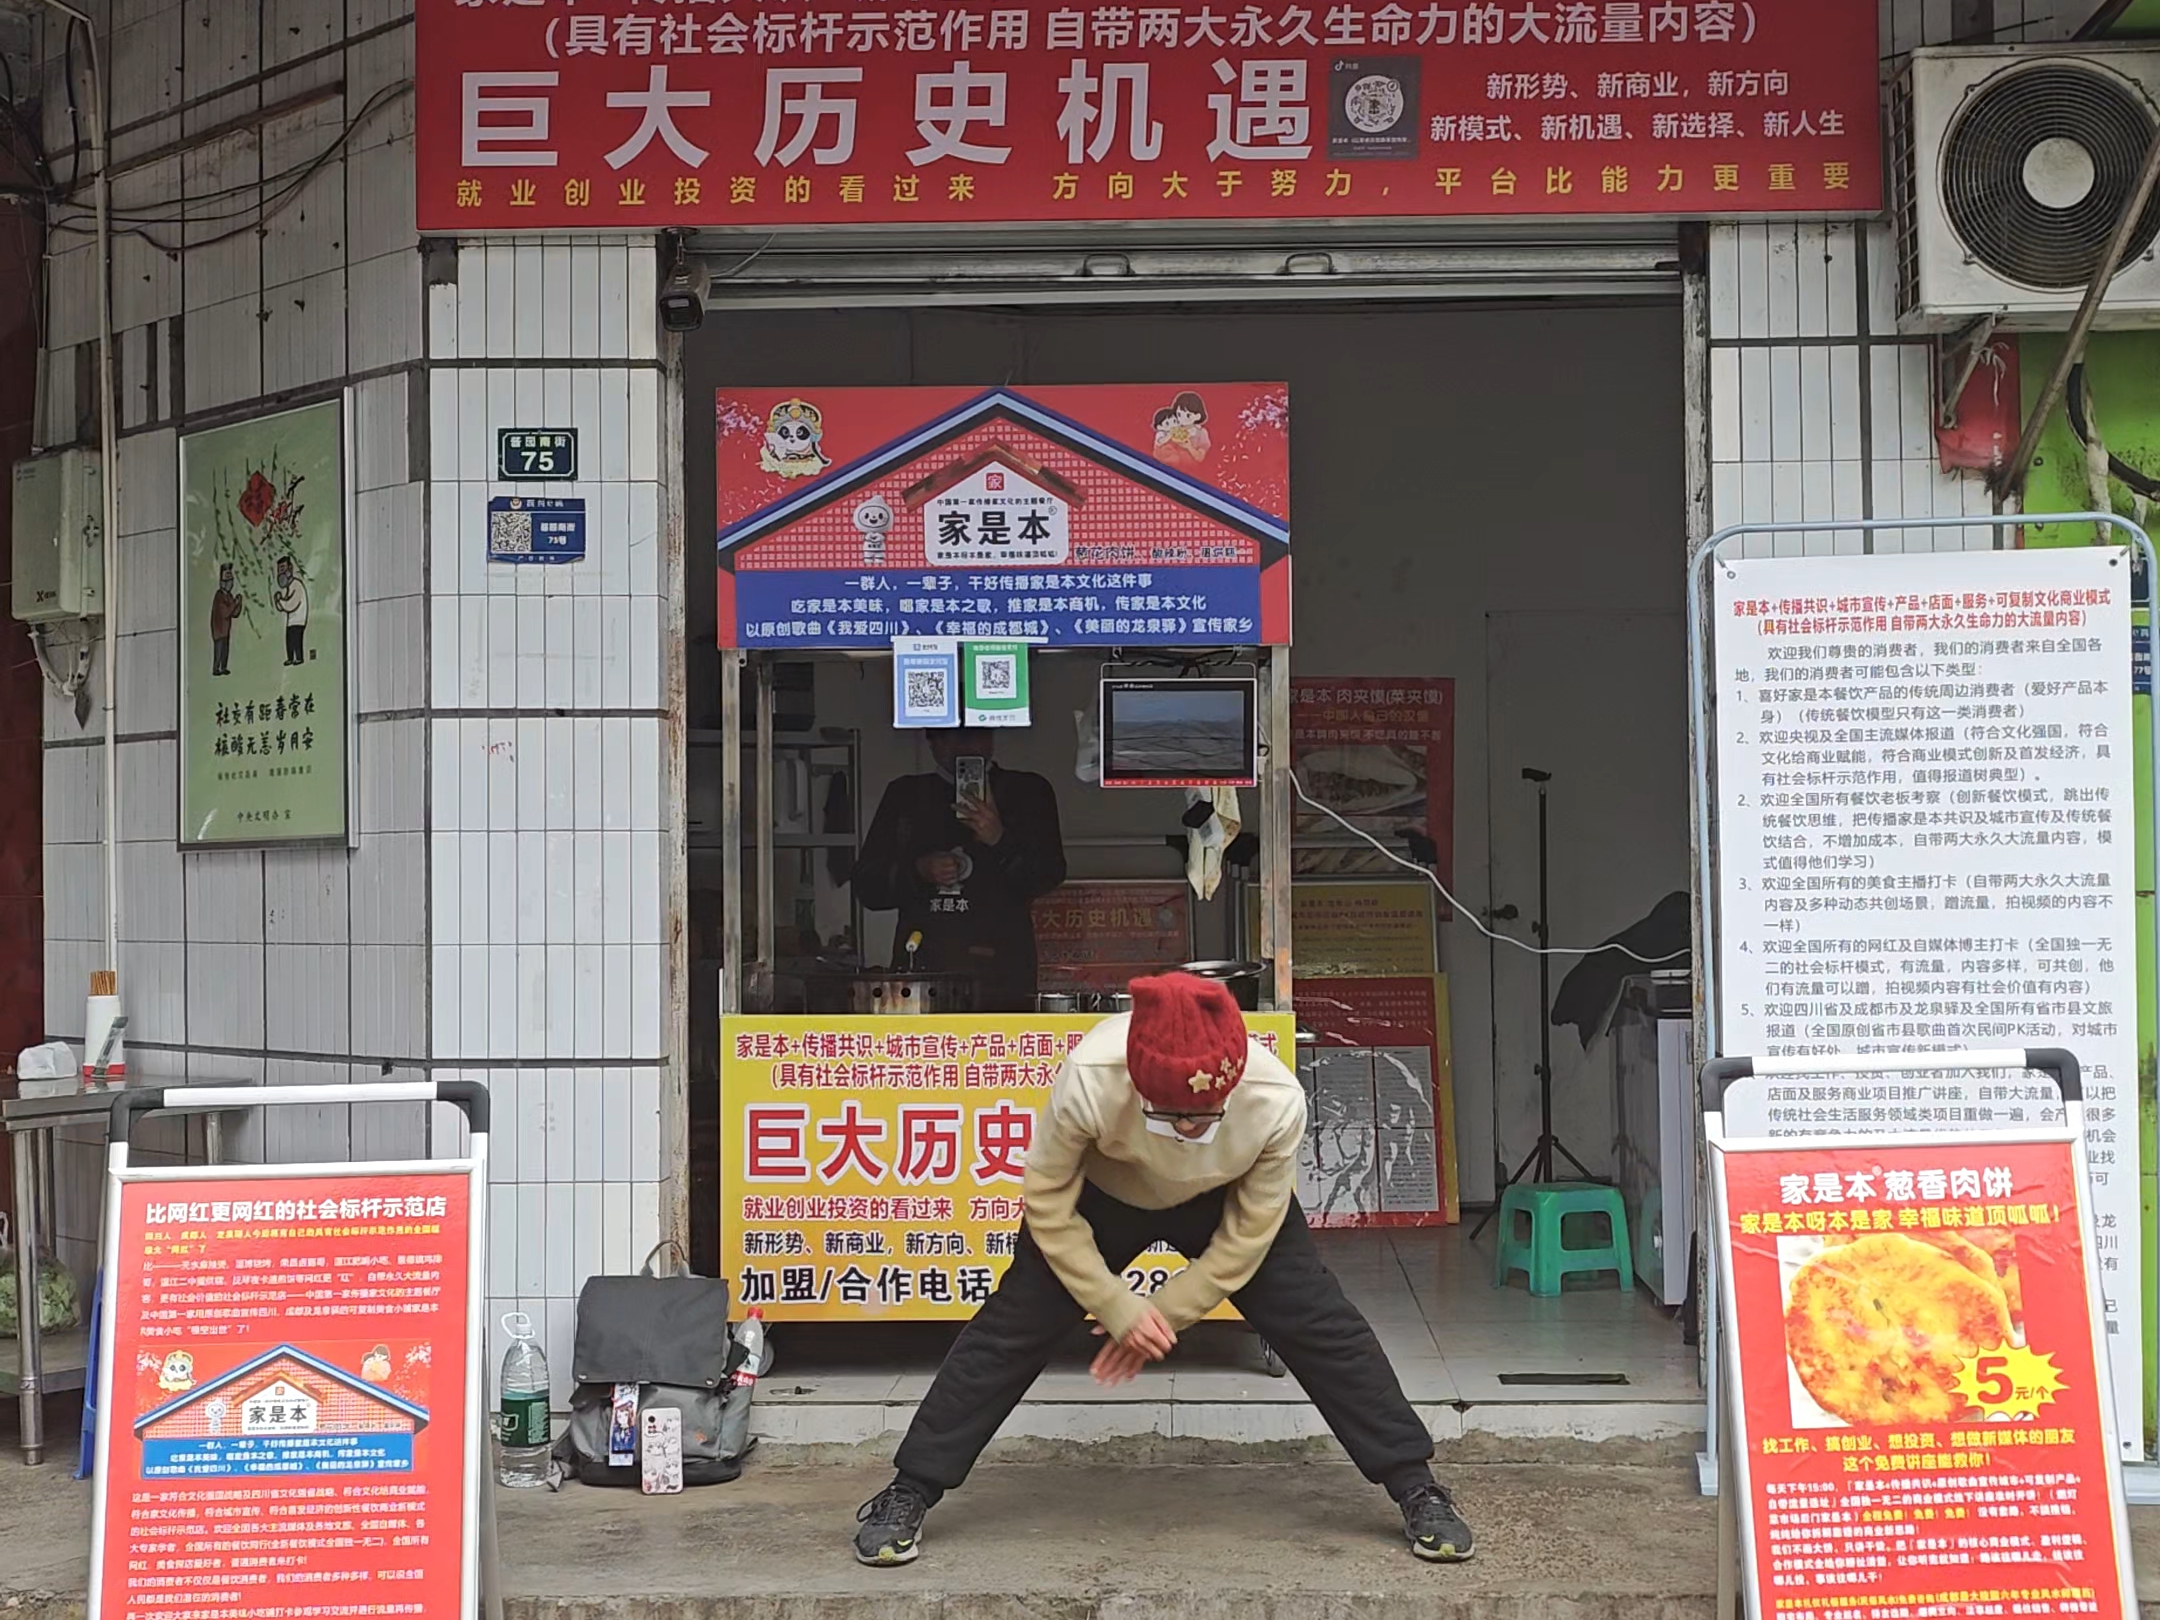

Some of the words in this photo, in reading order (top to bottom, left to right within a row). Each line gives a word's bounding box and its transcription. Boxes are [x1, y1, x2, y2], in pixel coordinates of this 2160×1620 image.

[545, 12, 1028, 58] (具有社会标杆示范作用
[1047, 3, 1756, 49] 自带两大永久生命力的大流量内容)
[461, 58, 1311, 169] 巨大历史机遇
[1430, 110, 1845, 142] 新模式、新机遇、新选择、新人生
[456, 175, 975, 207] 就业创业投资的看过来
[1436, 163, 1850, 195] 平台比能力更重要
[521, 451, 554, 471] 75
[938, 509, 1051, 546] 家是本
[772, 1063, 958, 1088] (具有社会标杆示范作用
[747, 1103, 1034, 1181] 巨大历史
[146, 1196, 447, 1224] 比网红更网红的社会标杆示范店
[744, 1198, 952, 1221] 就业创业投资的看过来
[1740, 1209, 1893, 1234] 家是本呀本是家
[741, 1266, 993, 1302] 加盟/合作电话
[1976, 1356, 2013, 1404] 5
[249, 1405, 307, 1424] 家是本
